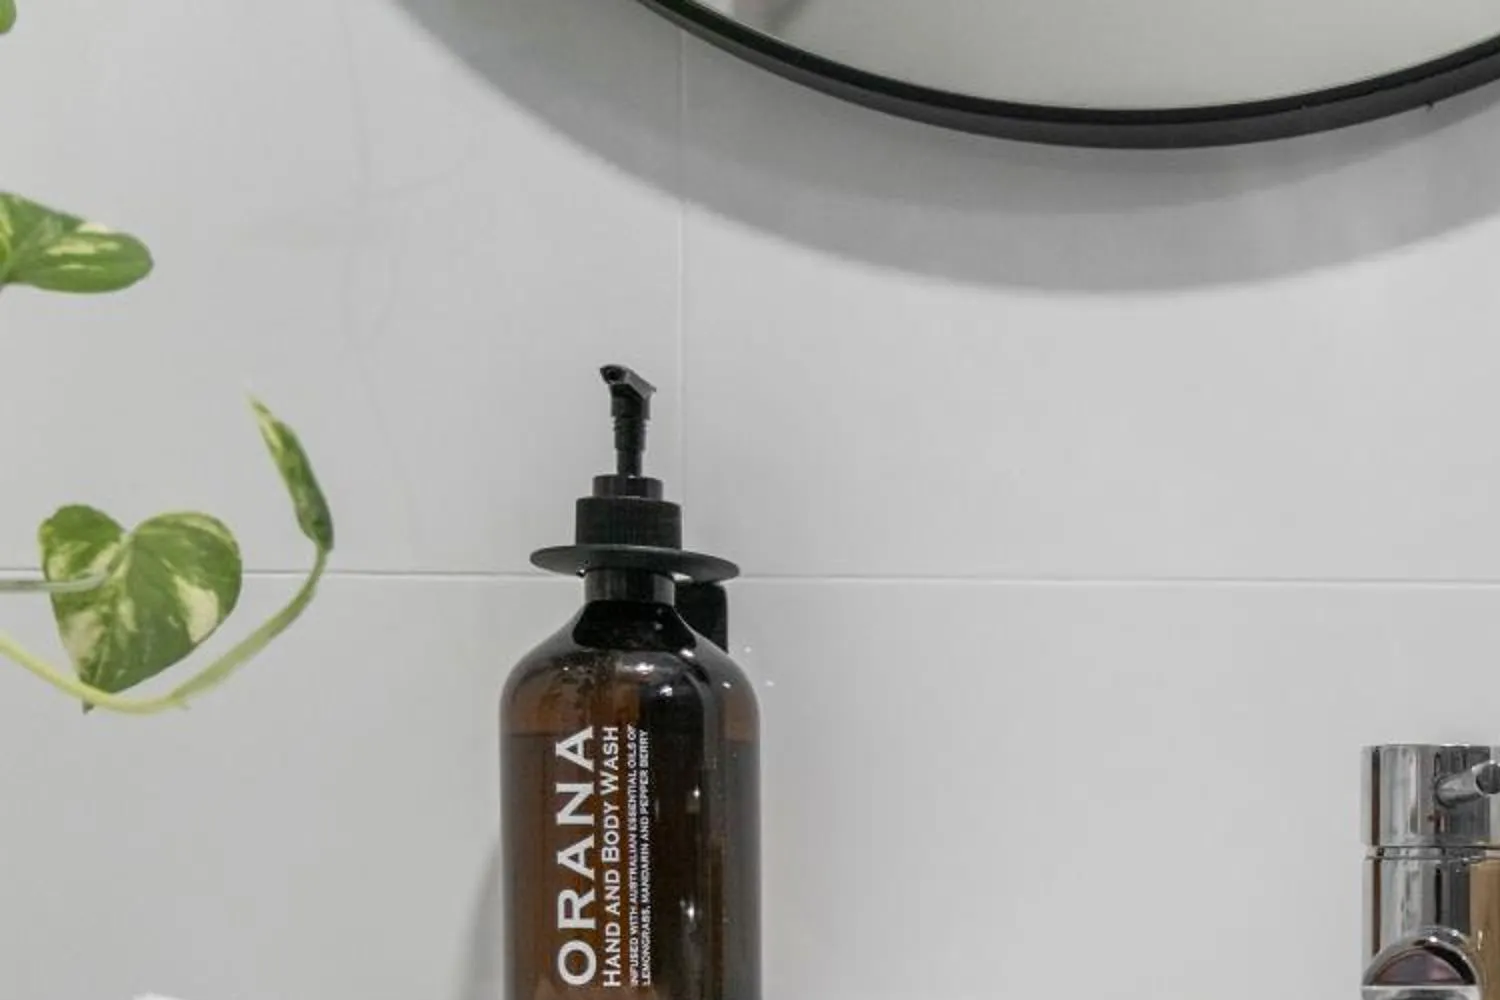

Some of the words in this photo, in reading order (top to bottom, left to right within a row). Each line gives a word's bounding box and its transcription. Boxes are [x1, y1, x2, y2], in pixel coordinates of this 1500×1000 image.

[627, 724, 635, 741] OF
[628, 743, 636, 768] OILS
[640, 730, 648, 766] BERRY
[600, 726, 619, 795] WASH
[628, 770, 637, 831] ESSENTIAL
[640, 770, 649, 814] PEPPER
[602, 801, 620, 862] BODY
[641, 817, 649, 841] AND
[556, 726, 596, 986] ORANA
[628, 834, 638, 903] AUSTRALIAN
[641, 844, 650, 903] MANDARIN
[604, 869, 620, 916] AND
[630, 906, 638, 934] WITH
[642, 906, 652, 986] LEMONGRASS,
[602, 922, 620, 986] HAND
[630, 938, 638, 986] INFUSED
